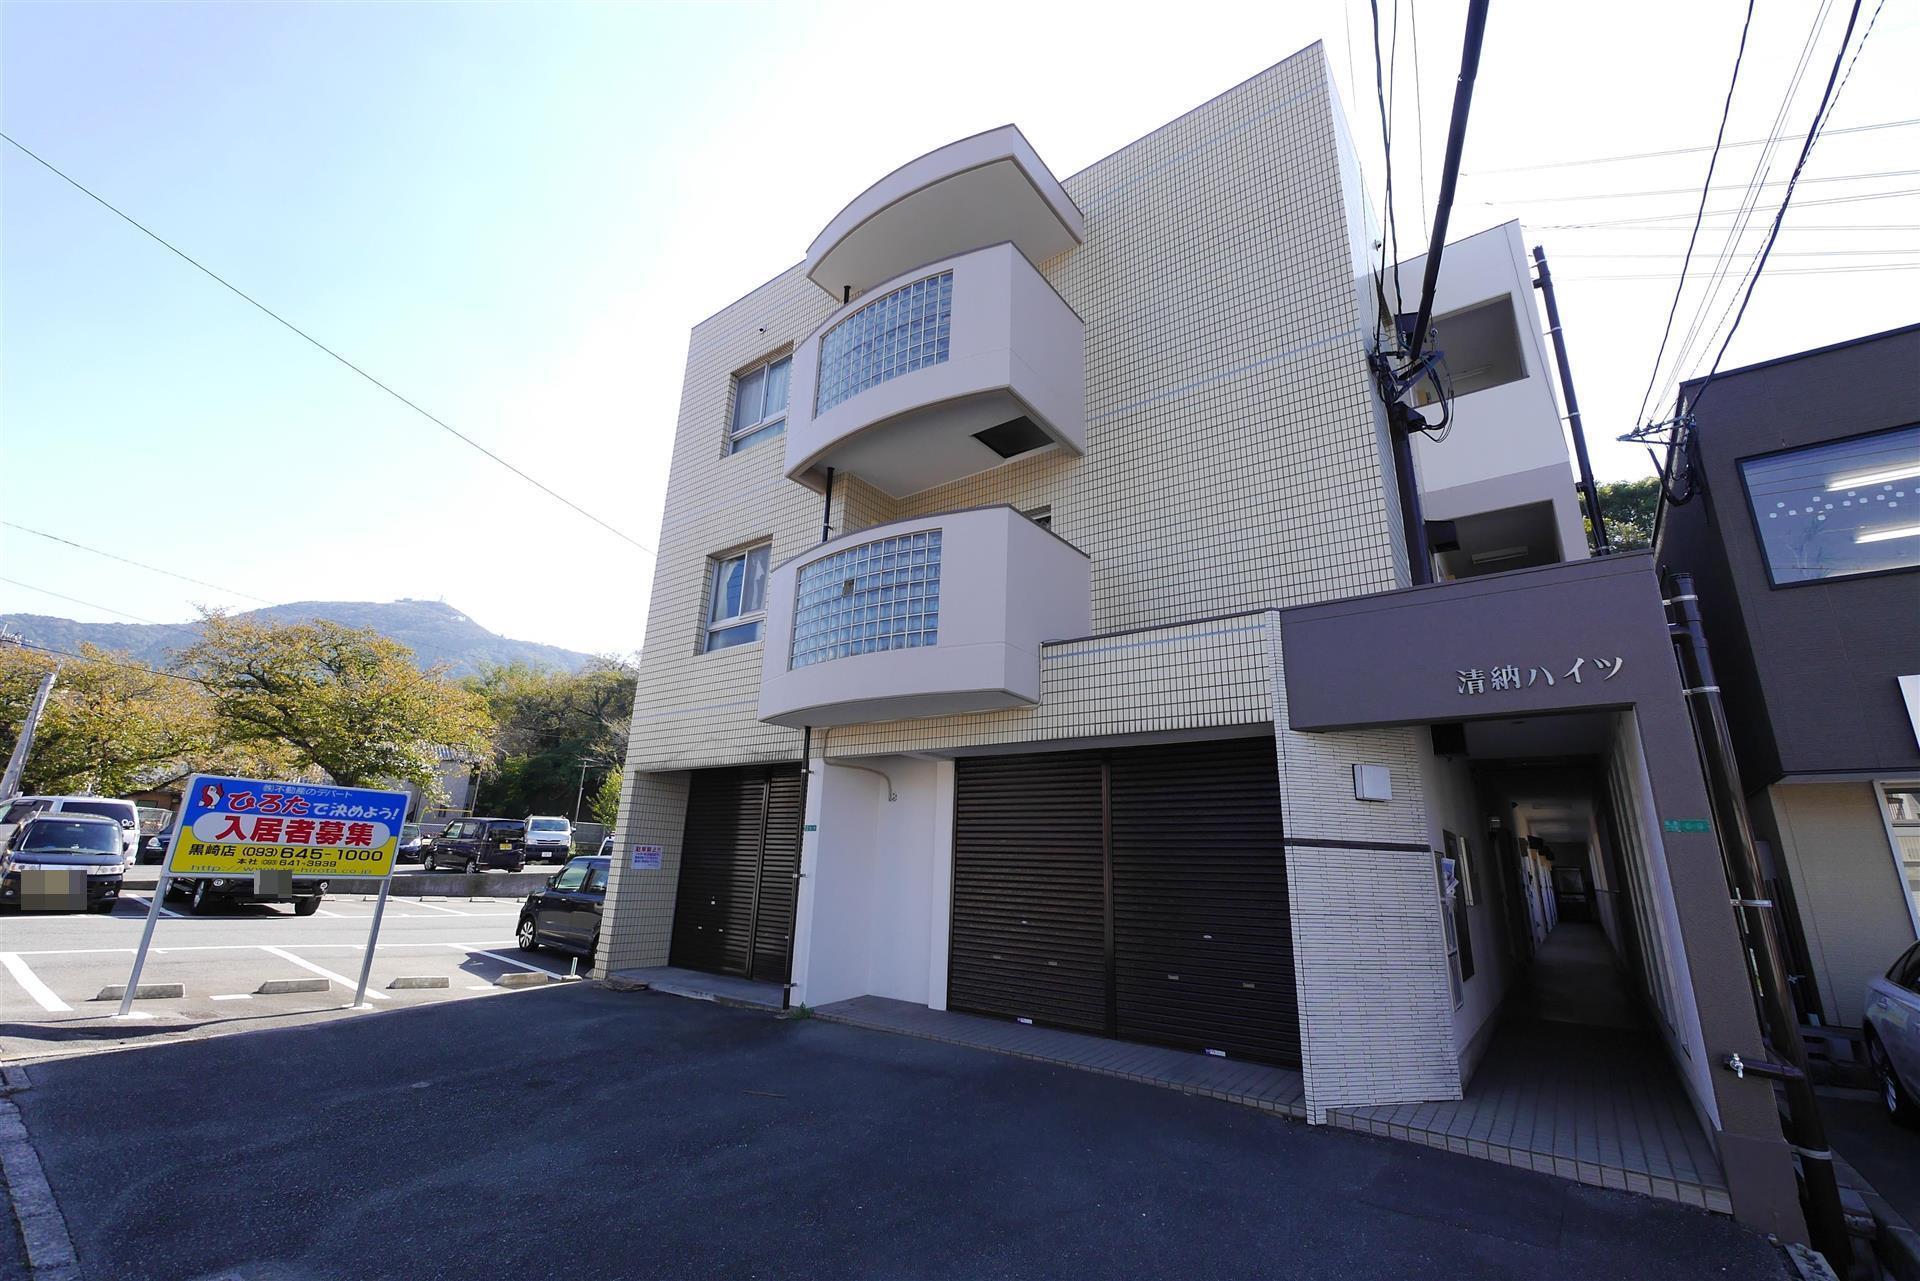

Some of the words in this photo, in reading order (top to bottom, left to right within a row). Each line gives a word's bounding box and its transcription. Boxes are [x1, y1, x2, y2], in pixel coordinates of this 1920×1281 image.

[1456, 656, 1623, 695] 清納ハイツ
[215, 815, 375, 847] 入居者募集
[188, 843, 237, 857] 黒崎店
